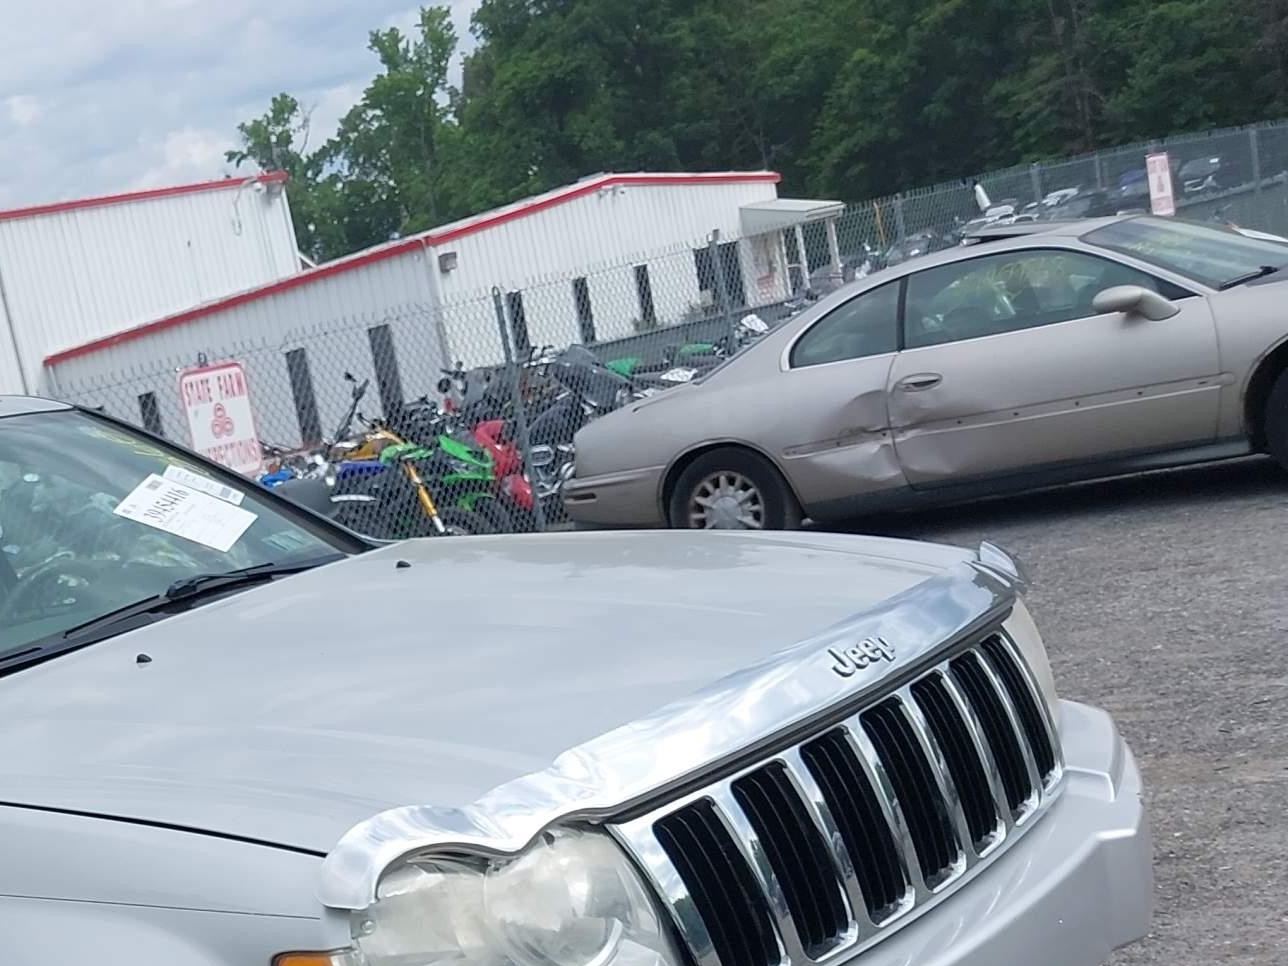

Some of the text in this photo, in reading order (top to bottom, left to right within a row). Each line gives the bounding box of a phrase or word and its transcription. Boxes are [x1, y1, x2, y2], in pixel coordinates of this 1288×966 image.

[184, 372, 246, 407] STATE FARM
[827, 636, 896, 678] Jeep
